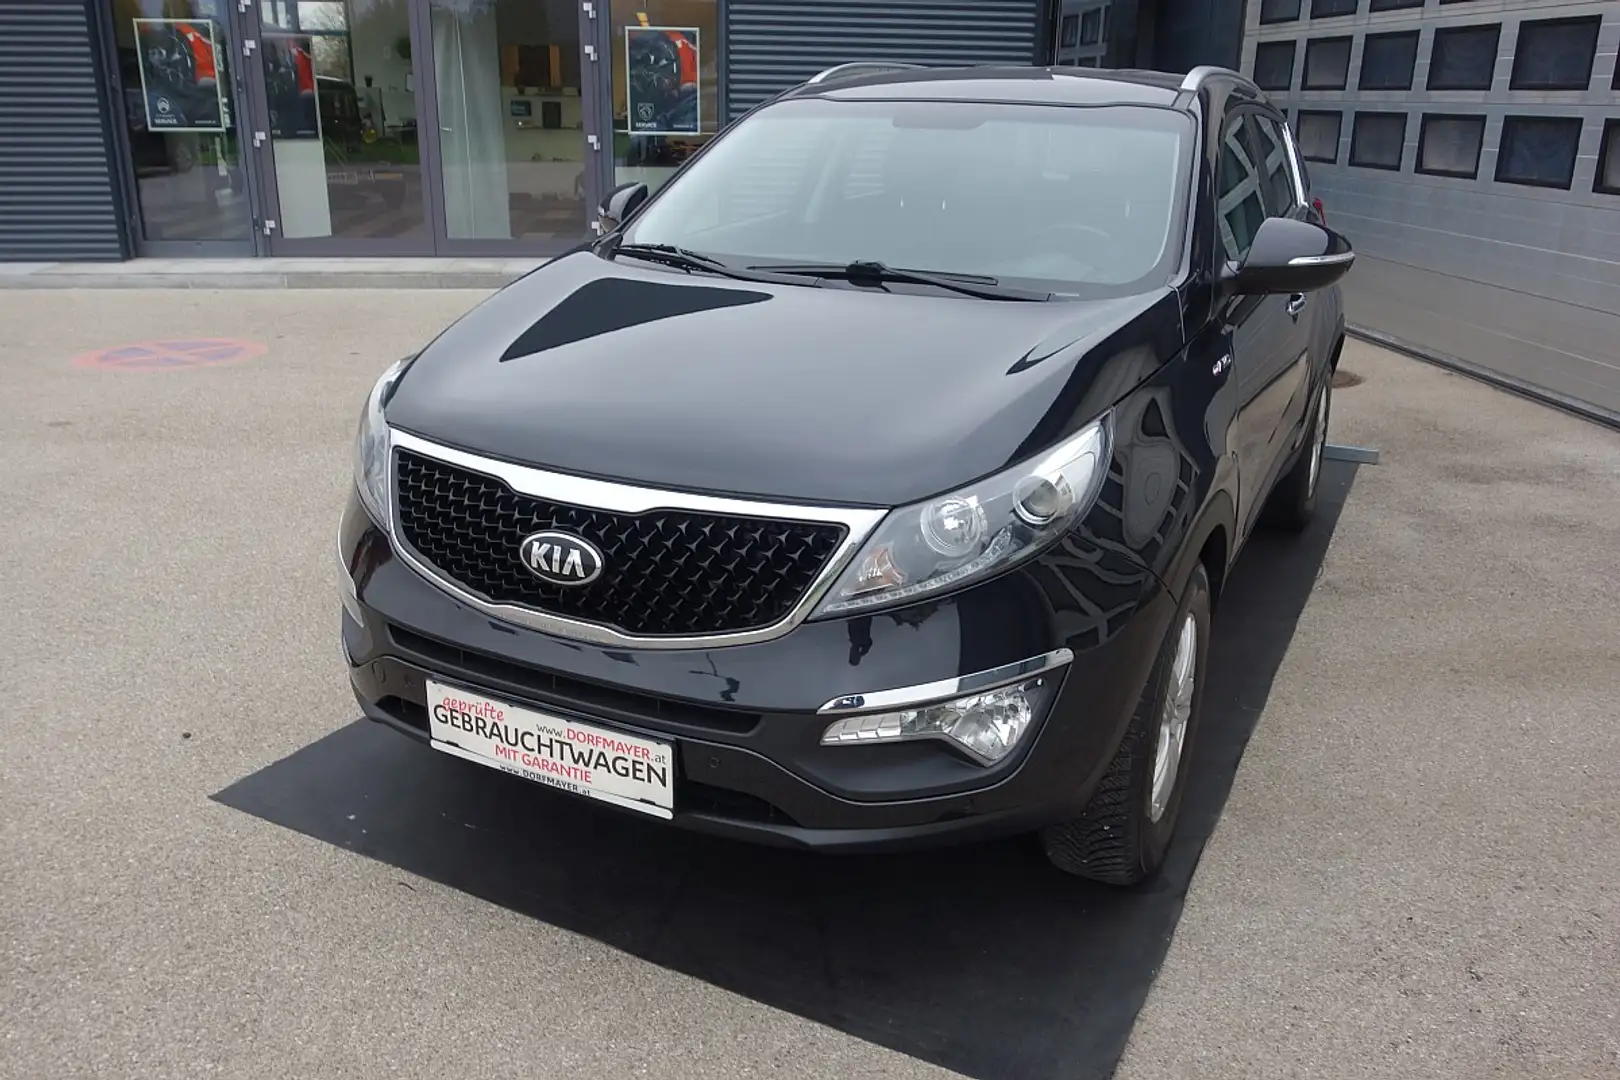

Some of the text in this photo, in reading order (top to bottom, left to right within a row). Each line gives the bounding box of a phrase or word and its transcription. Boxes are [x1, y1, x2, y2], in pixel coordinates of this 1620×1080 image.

[531, 541, 585, 578] KIA
[443, 696, 504, 721] geprüfte
[434, 704, 667, 788] GEBRAUCHTWAGEN
[495, 744, 592, 784] MIT GARANTIE
[536, 724, 666, 765] www.DORFMAYER.at
